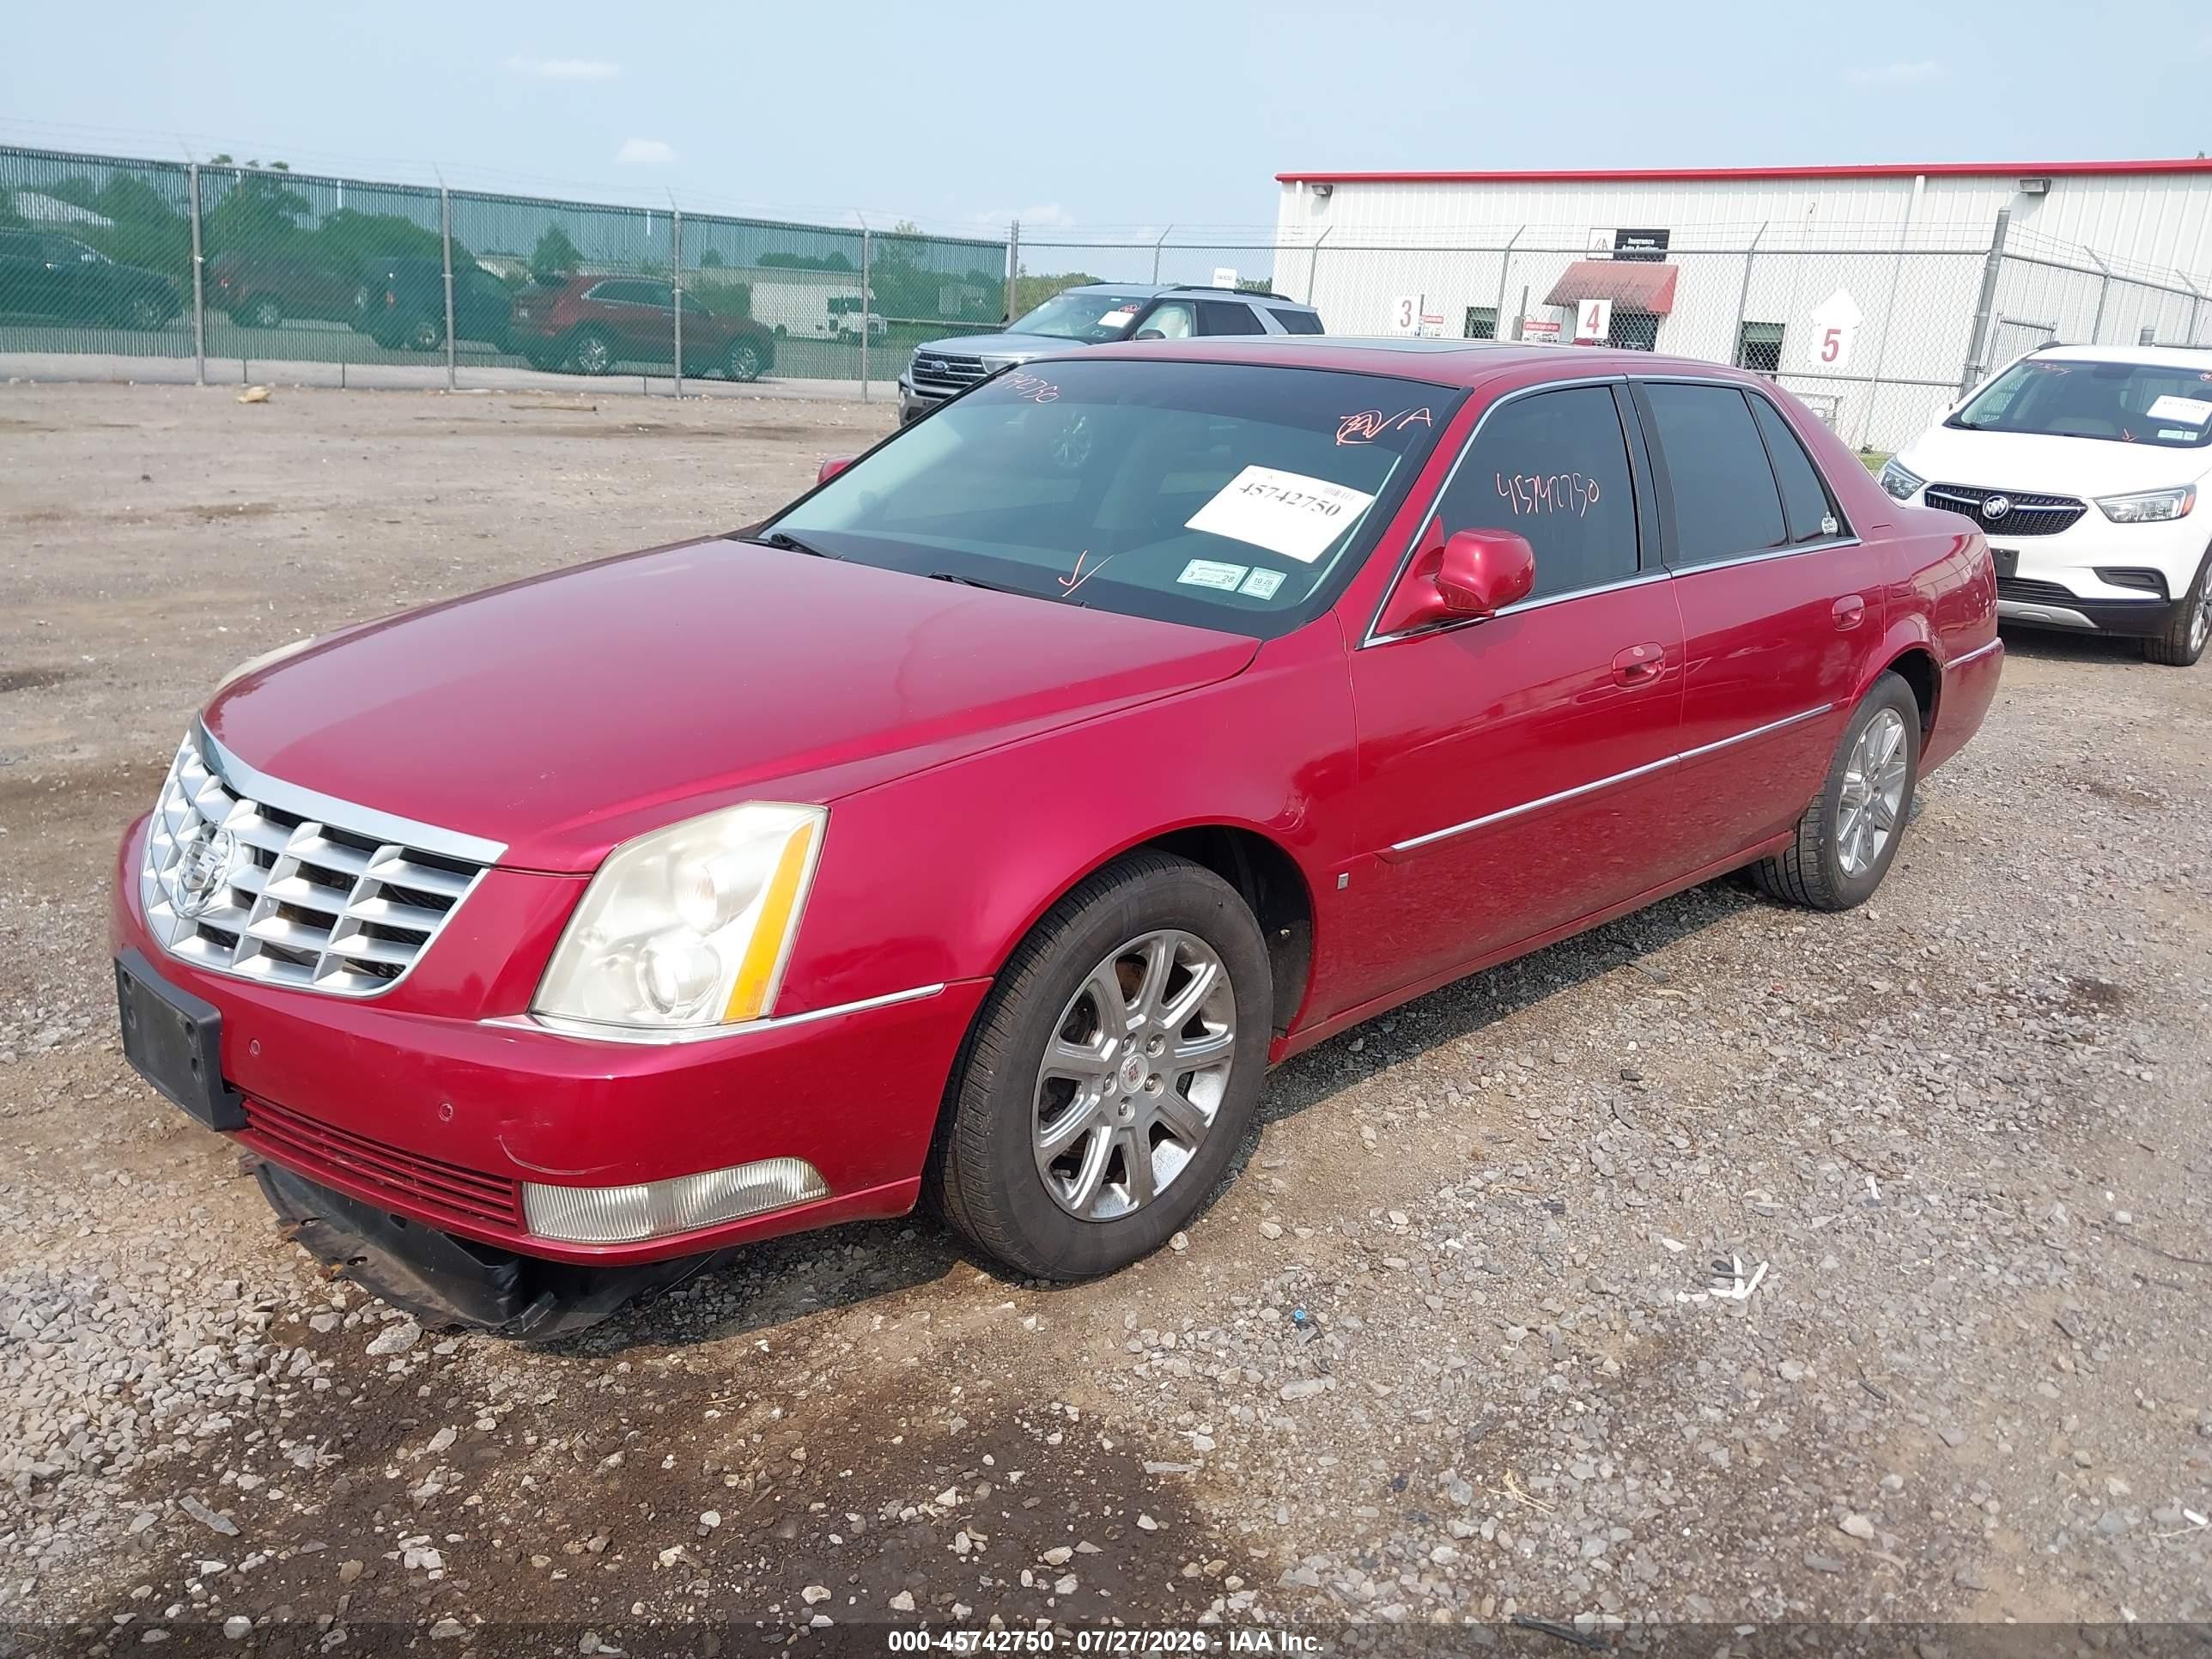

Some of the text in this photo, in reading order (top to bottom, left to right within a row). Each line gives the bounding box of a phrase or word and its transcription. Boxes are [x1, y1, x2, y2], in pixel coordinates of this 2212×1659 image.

[1400, 299, 1413, 328] 3
[1585, 303, 1601, 335] 4
[1821, 328, 1842, 362] 5
[1239, 482, 1343, 517] 45742750
